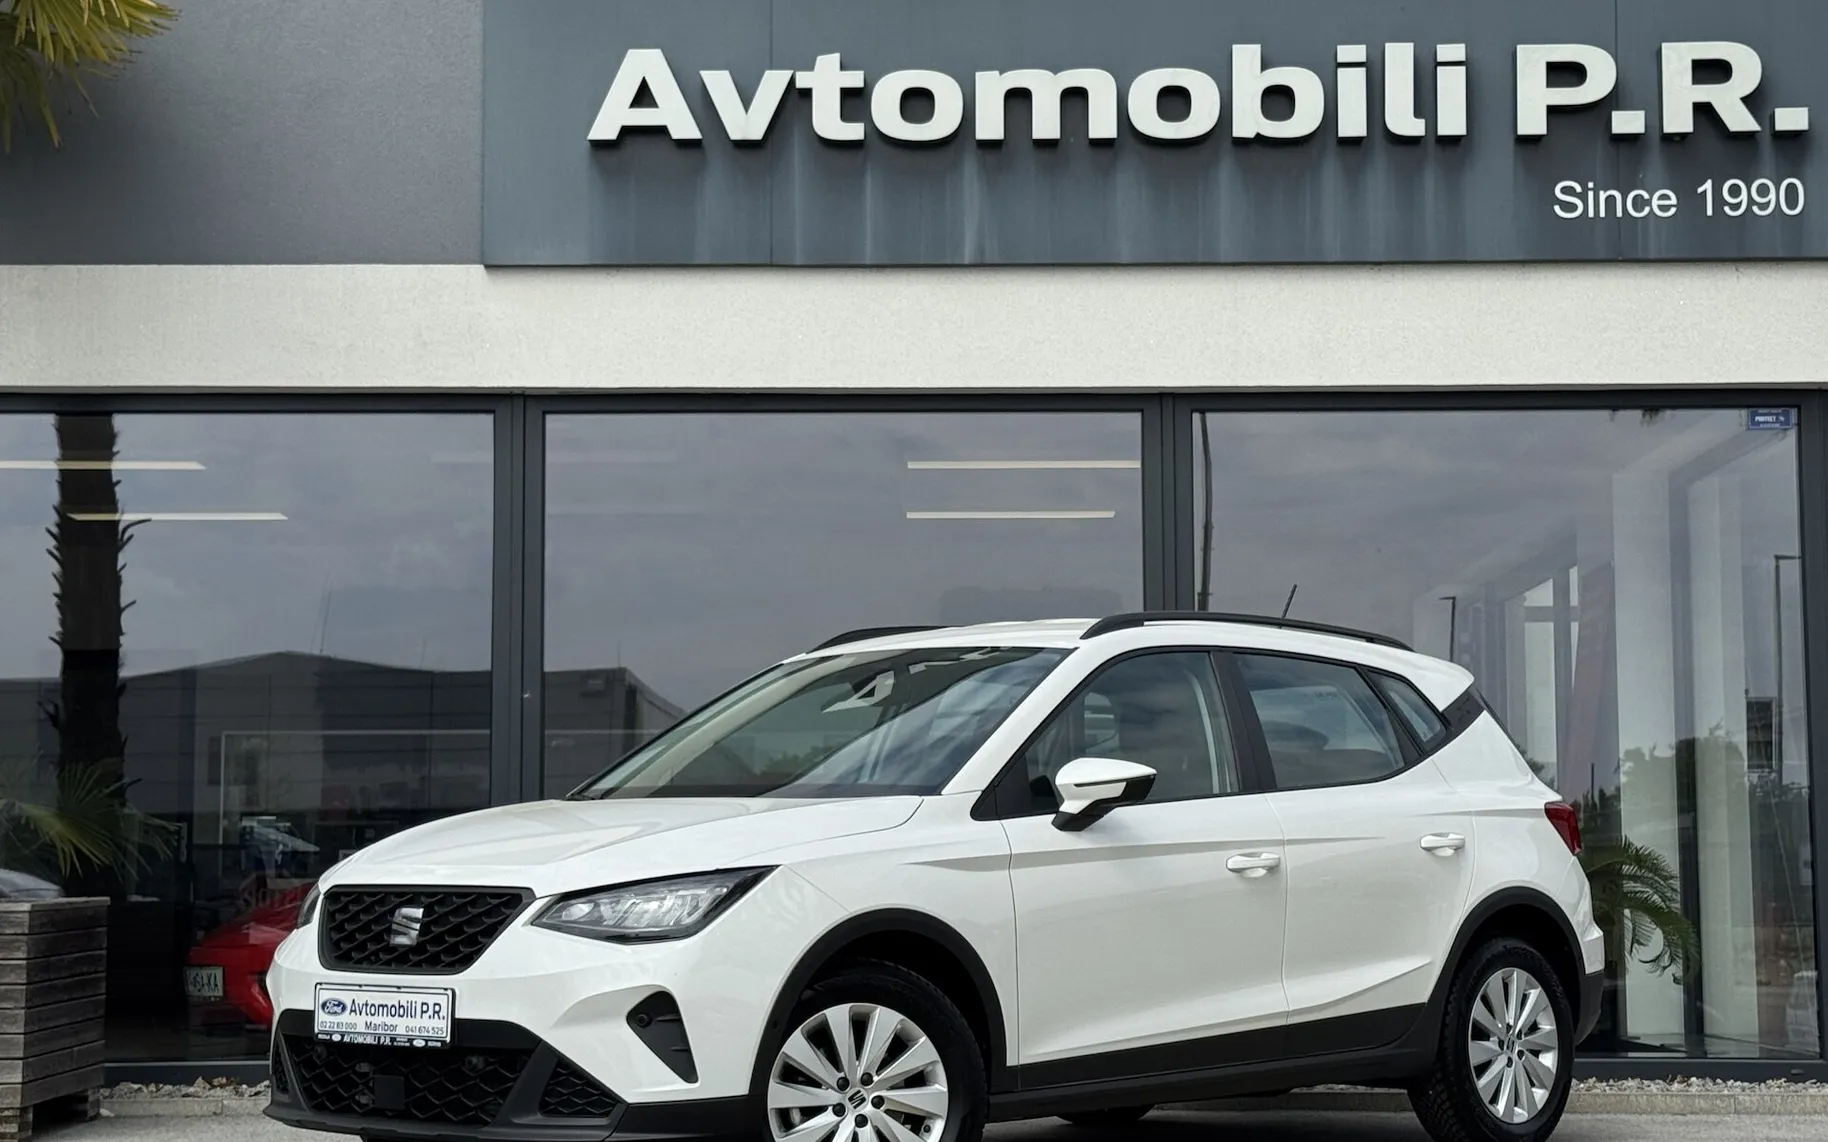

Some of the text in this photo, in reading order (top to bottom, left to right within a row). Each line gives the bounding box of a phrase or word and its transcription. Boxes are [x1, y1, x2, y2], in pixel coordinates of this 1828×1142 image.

[587, 41, 1810, 142] Avtomobili P.R.
[1553, 178, 1805, 218] Since 1990
[349, 998, 446, 1020] Avtomobili P.R.
[320, 1020, 327, 1029] 02
[328, 1021, 335, 1029] 22
[344, 1022, 358, 1031] 000
[364, 1020, 398, 1032] Maribor
[405, 1025, 445, 1036] 041 674 525
